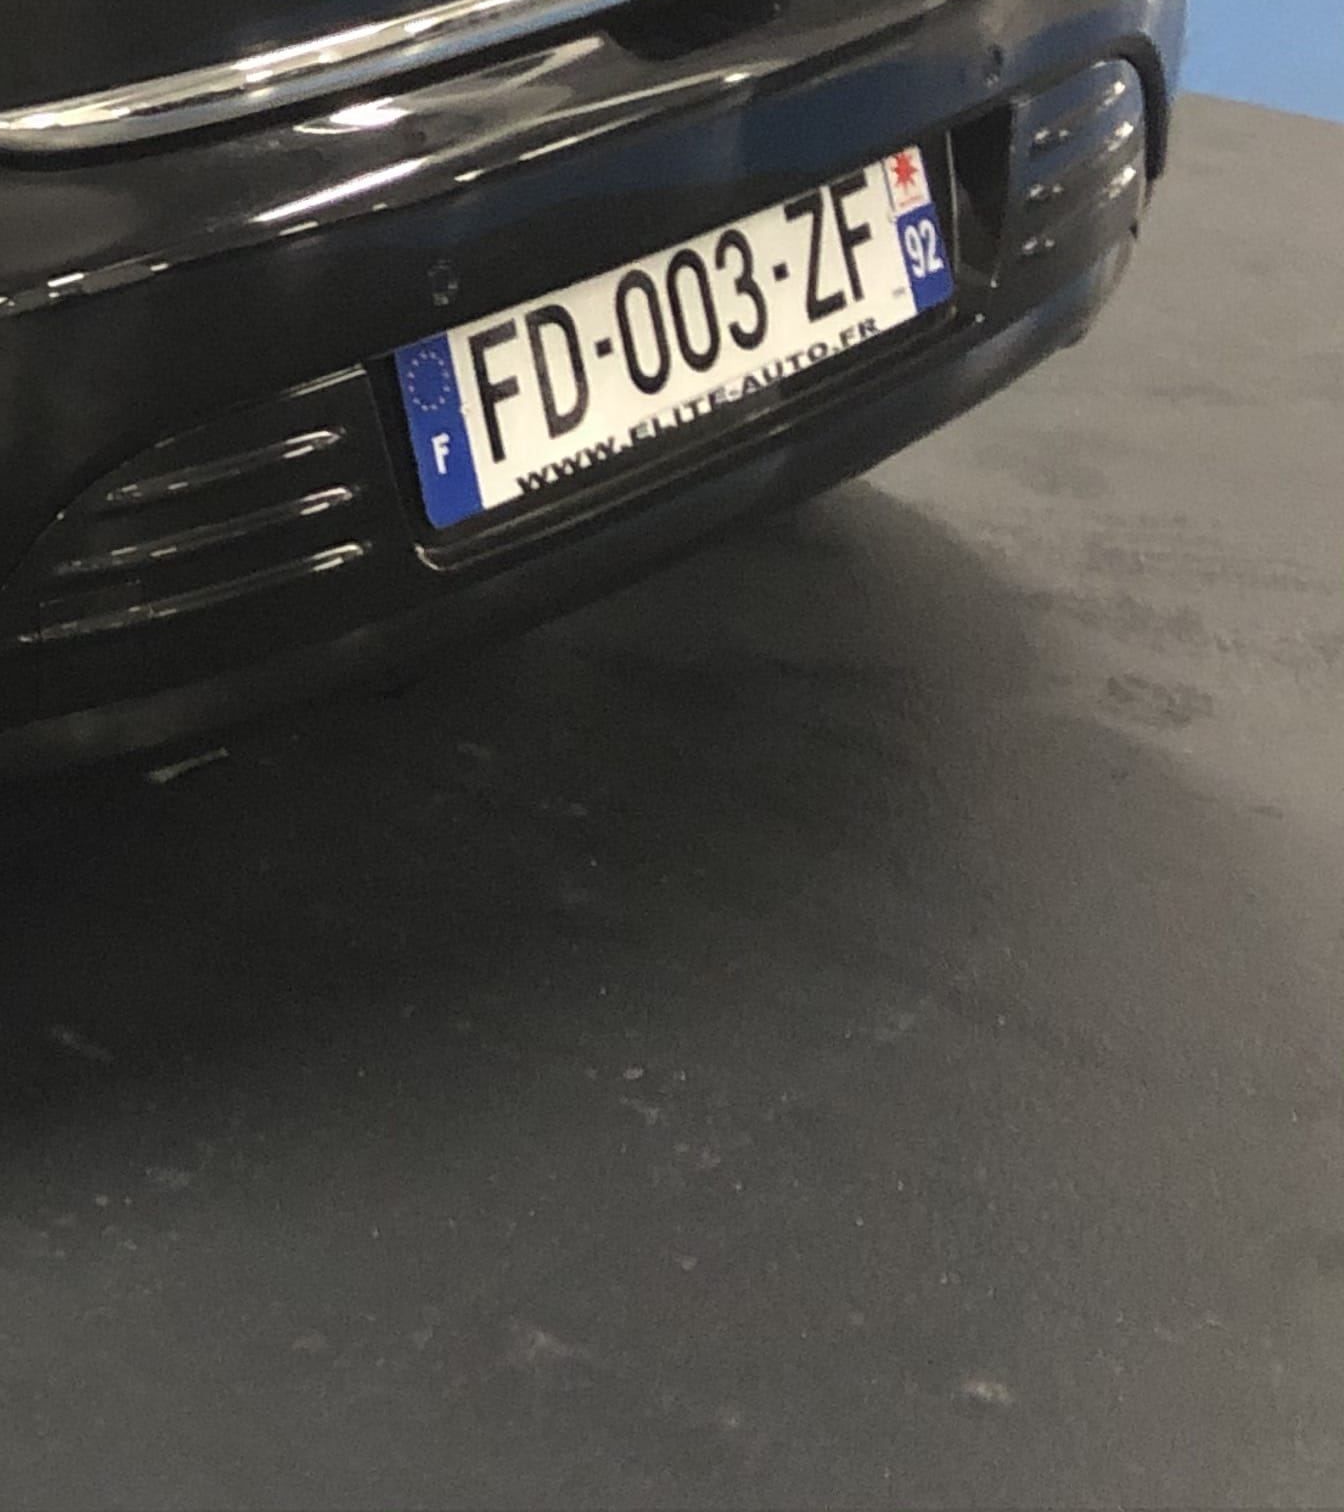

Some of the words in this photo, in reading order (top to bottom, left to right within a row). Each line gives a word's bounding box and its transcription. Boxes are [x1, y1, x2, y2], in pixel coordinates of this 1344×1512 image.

[904, 219, 944, 279] 92
[468, 173, 872, 463] FD-003-ZF
[431, 433, 452, 475] F
[515, 317, 879, 495] WWW.ELITE-AUTO.FR
